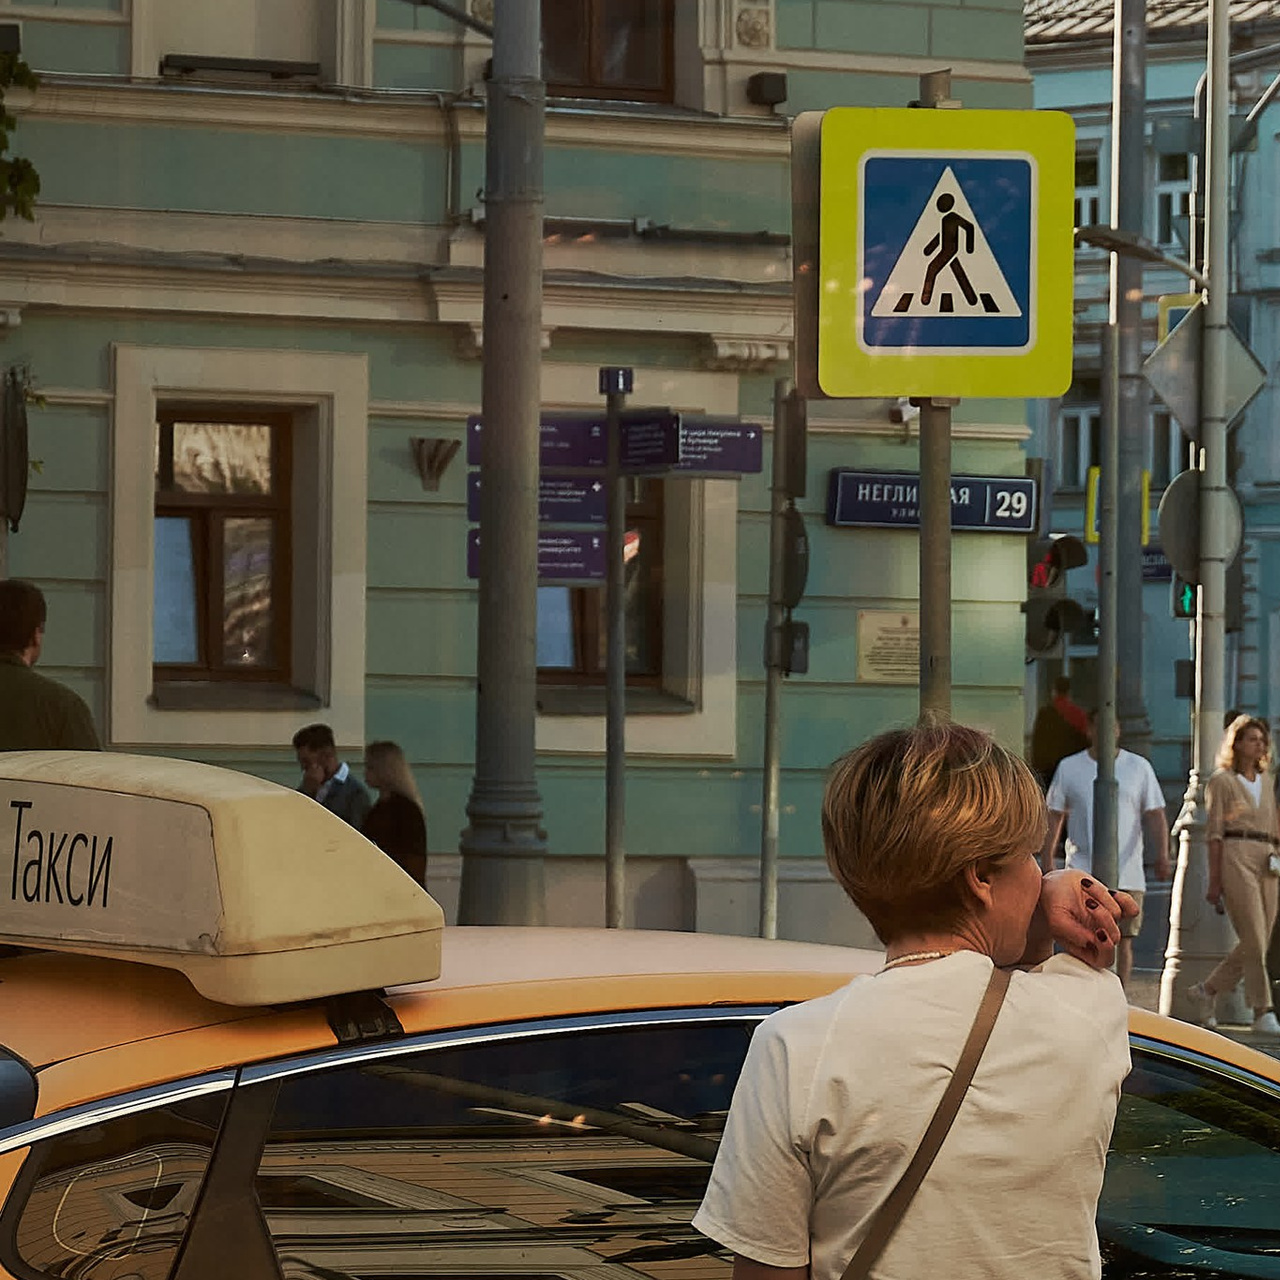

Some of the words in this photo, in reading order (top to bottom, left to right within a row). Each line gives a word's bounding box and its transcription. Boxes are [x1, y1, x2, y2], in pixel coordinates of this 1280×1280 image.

[857, 482, 971, 505] НЕГЛИАЯ
[995, 491, 1028, 519] 29
[9, 800, 114, 909] Такси
